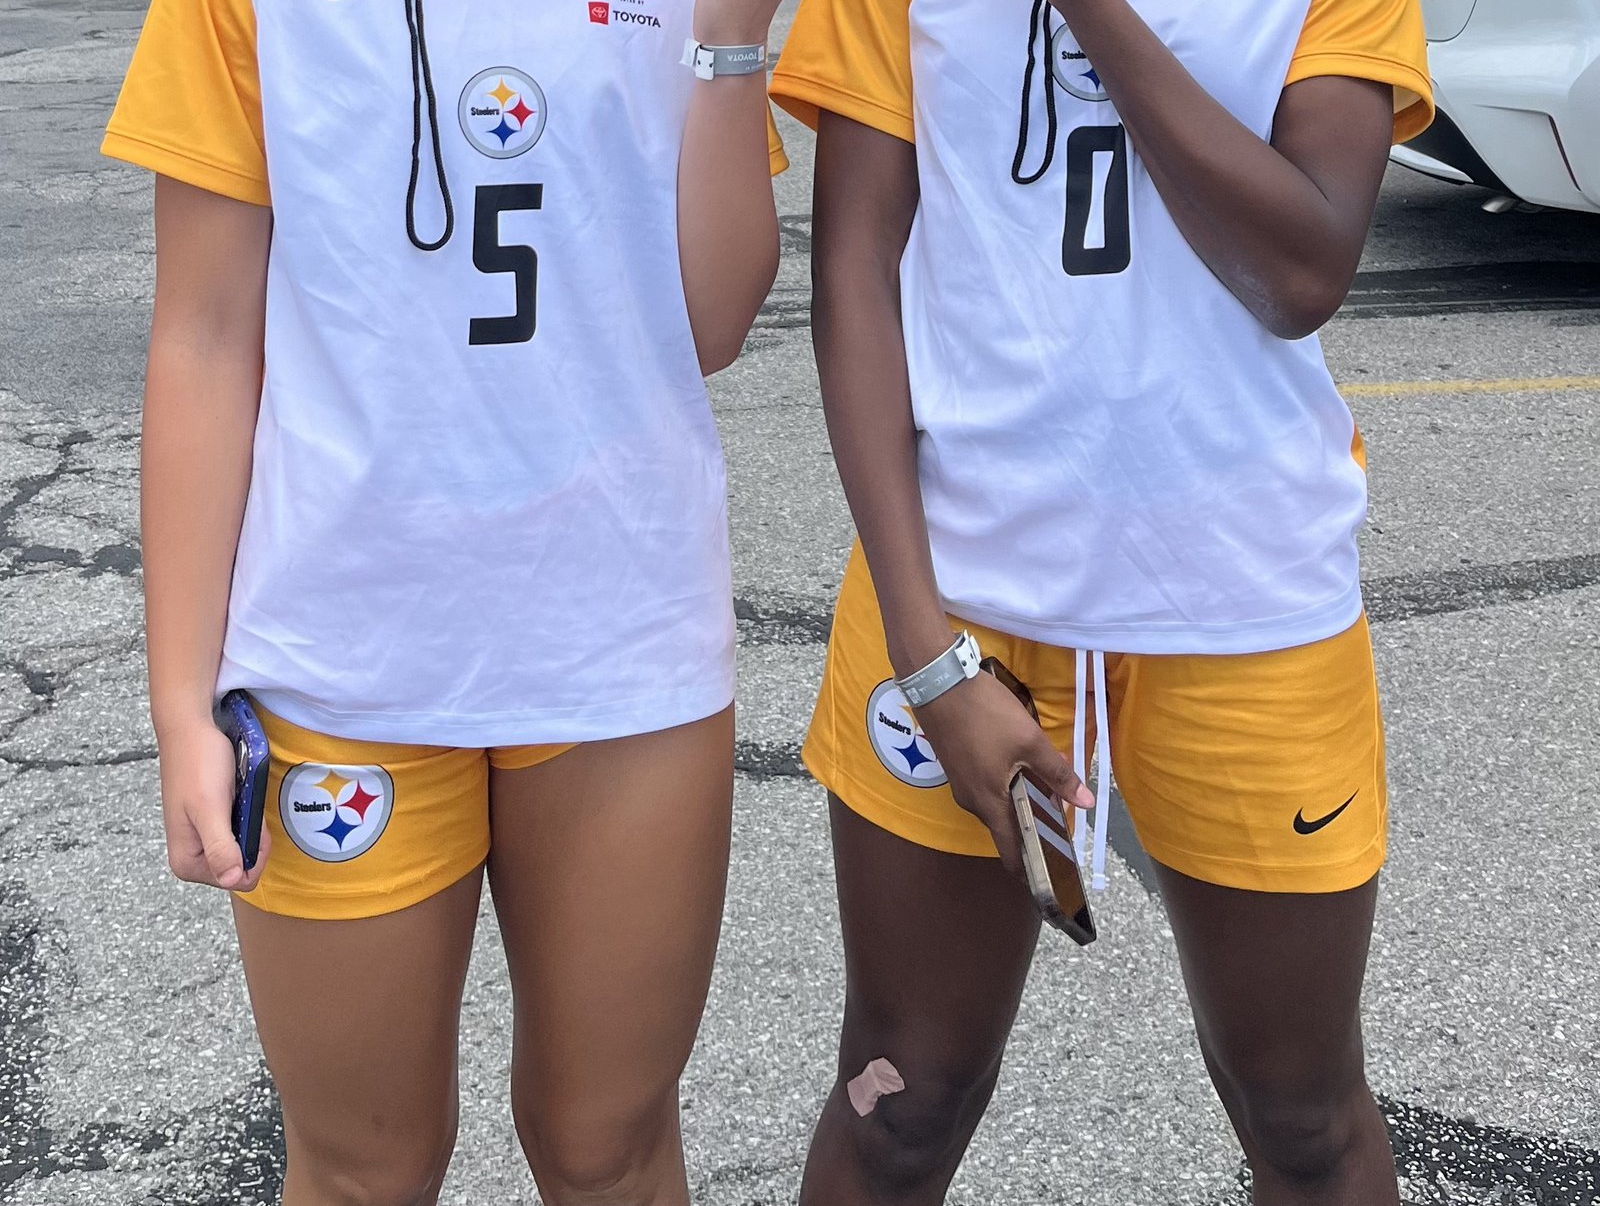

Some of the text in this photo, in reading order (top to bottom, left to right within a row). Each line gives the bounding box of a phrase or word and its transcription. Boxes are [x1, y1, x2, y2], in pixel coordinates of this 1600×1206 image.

[612, 9, 662, 29] TOYOTA
[727, 52, 758, 62] TOYOTA
[1061, 50, 1088, 60] Steele
[470, 106, 500, 116] Steelers
[1062, 122, 1131, 276] 0
[468, 182, 543, 345] 5
[878, 711, 912, 736] Steelers
[293, 801, 332, 813] Steelers
